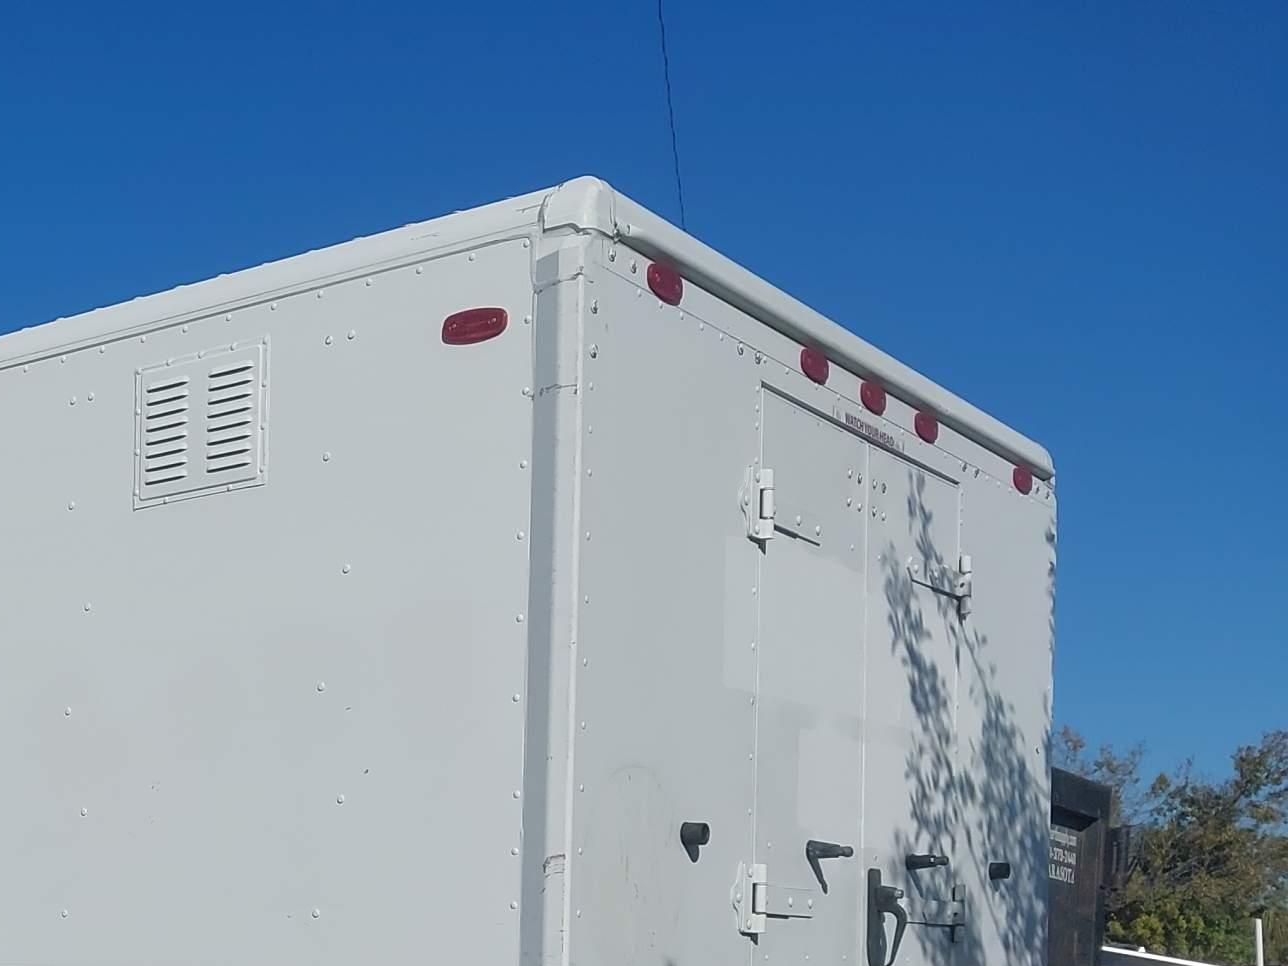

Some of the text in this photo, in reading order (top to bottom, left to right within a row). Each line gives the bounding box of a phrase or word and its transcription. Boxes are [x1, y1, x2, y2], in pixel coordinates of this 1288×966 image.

[845, 412, 895, 447] WATCH YOUR HEAD
